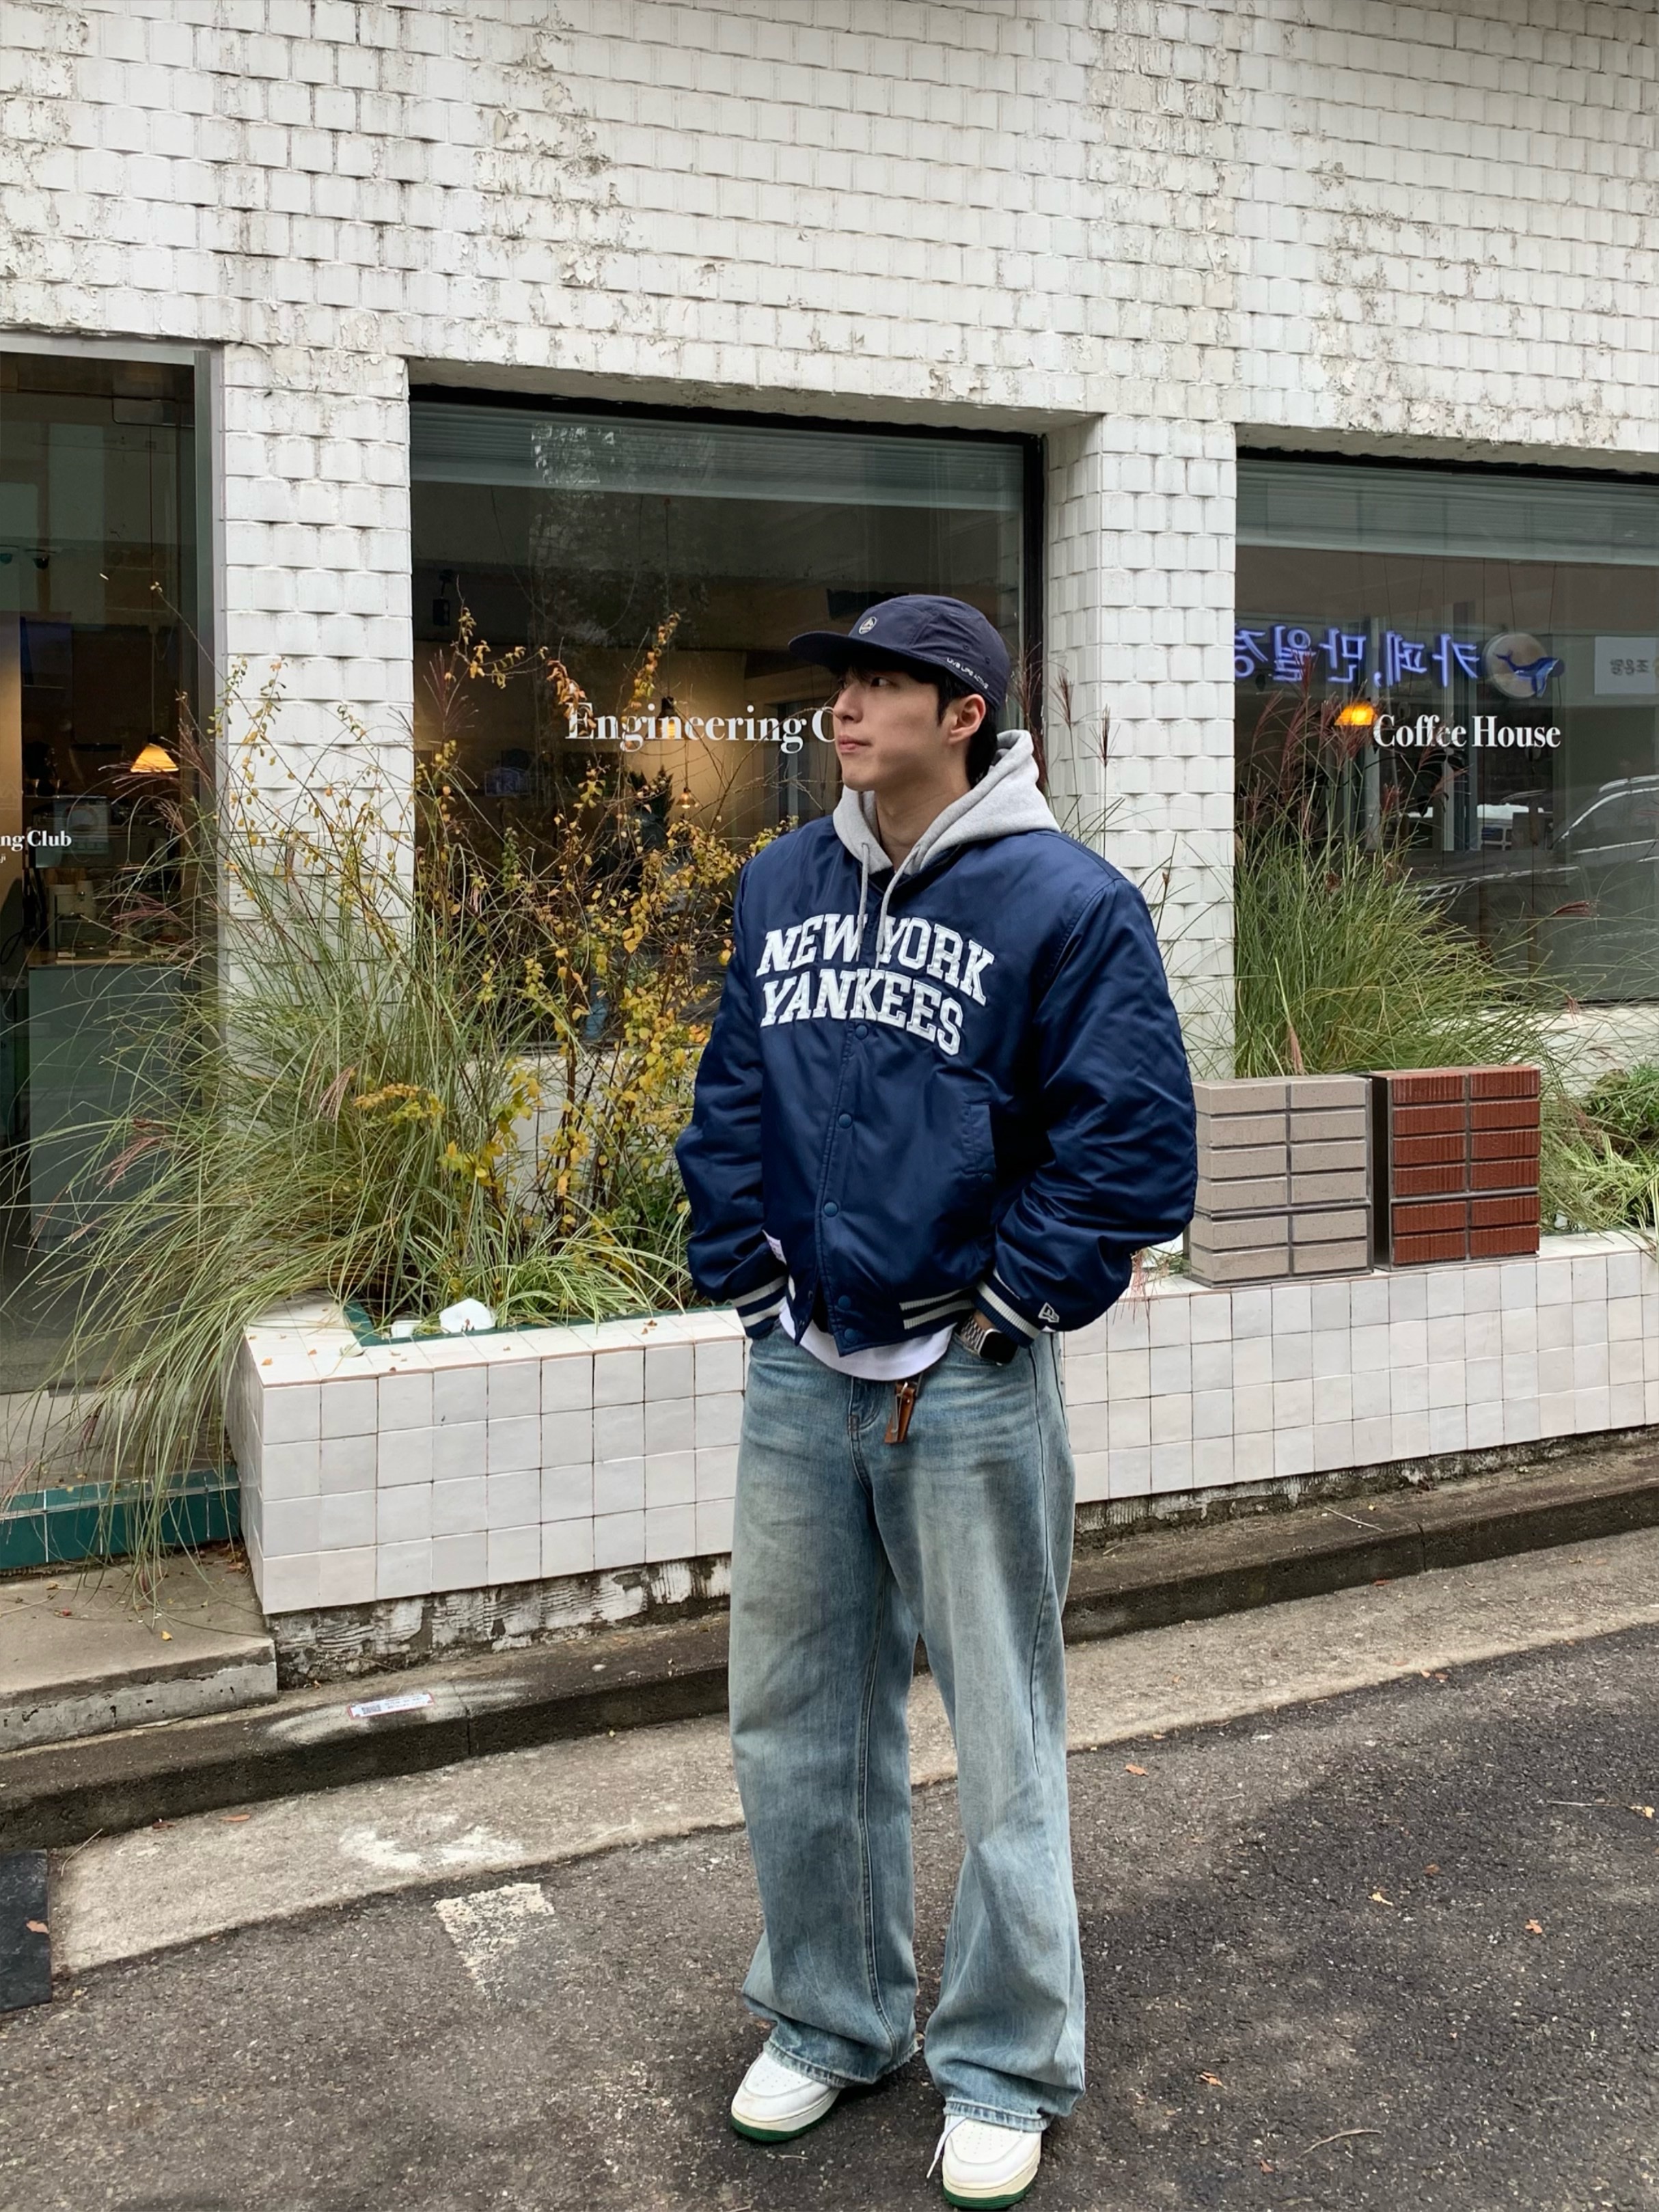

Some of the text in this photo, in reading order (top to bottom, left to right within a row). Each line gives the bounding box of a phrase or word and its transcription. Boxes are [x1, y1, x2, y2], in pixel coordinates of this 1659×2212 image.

[565, 702, 807, 754] Engineering
[1373, 714, 1561, 748] Coffee House
[27, 830, 72, 846] Club
[755, 913, 995, 1006] NEW YORK
[760, 968, 964, 1056] YANKEES
